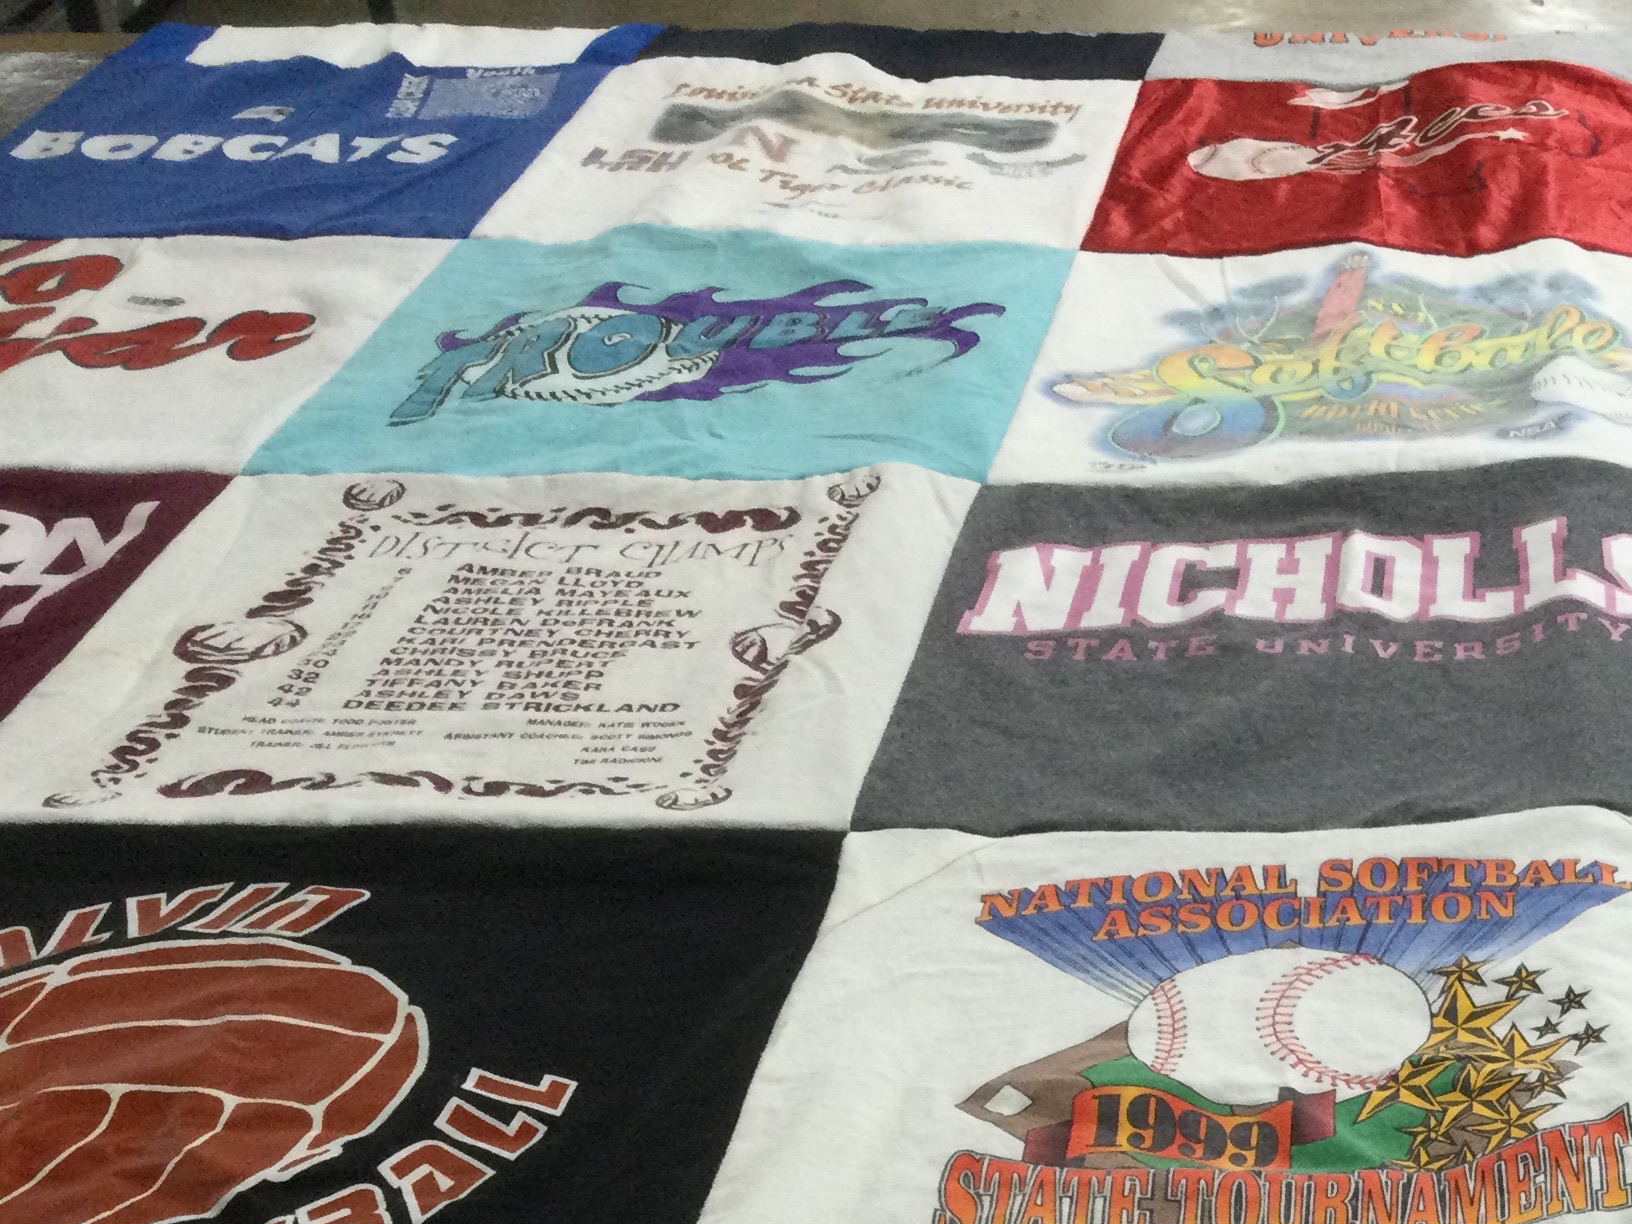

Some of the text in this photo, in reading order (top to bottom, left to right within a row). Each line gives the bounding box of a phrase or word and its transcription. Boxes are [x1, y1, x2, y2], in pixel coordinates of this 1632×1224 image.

[10, 129, 459, 164] BOBCATS
[456, 562, 663, 579] AMBER BRAUD
[446, 573, 644, 589] MEGAN LLOYD
[431, 596, 545, 606] ASHLEY
[421, 603, 525, 616] NICOLE
[413, 613, 531, 627] LAUREN
[406, 626, 692, 639] COURTNEY CHERRY
[1025, 611, 1631, 665] STATE UNIVERSITY
[379, 656, 483, 668] MANDY
[286, 668, 321, 685] 32
[371, 667, 490, 678] ASHLEY
[365, 677, 603, 692] TIFFANY BAKER
[353, 688, 473, 699] ASHLEY
[340, 699, 682, 714] DEEDEE STRICKLAND
[979, 862, 1299, 925] NATIONAL
[1091, 890, 1516, 942] ASSOCIATION
[1085, 1090, 1280, 1170] 1999
